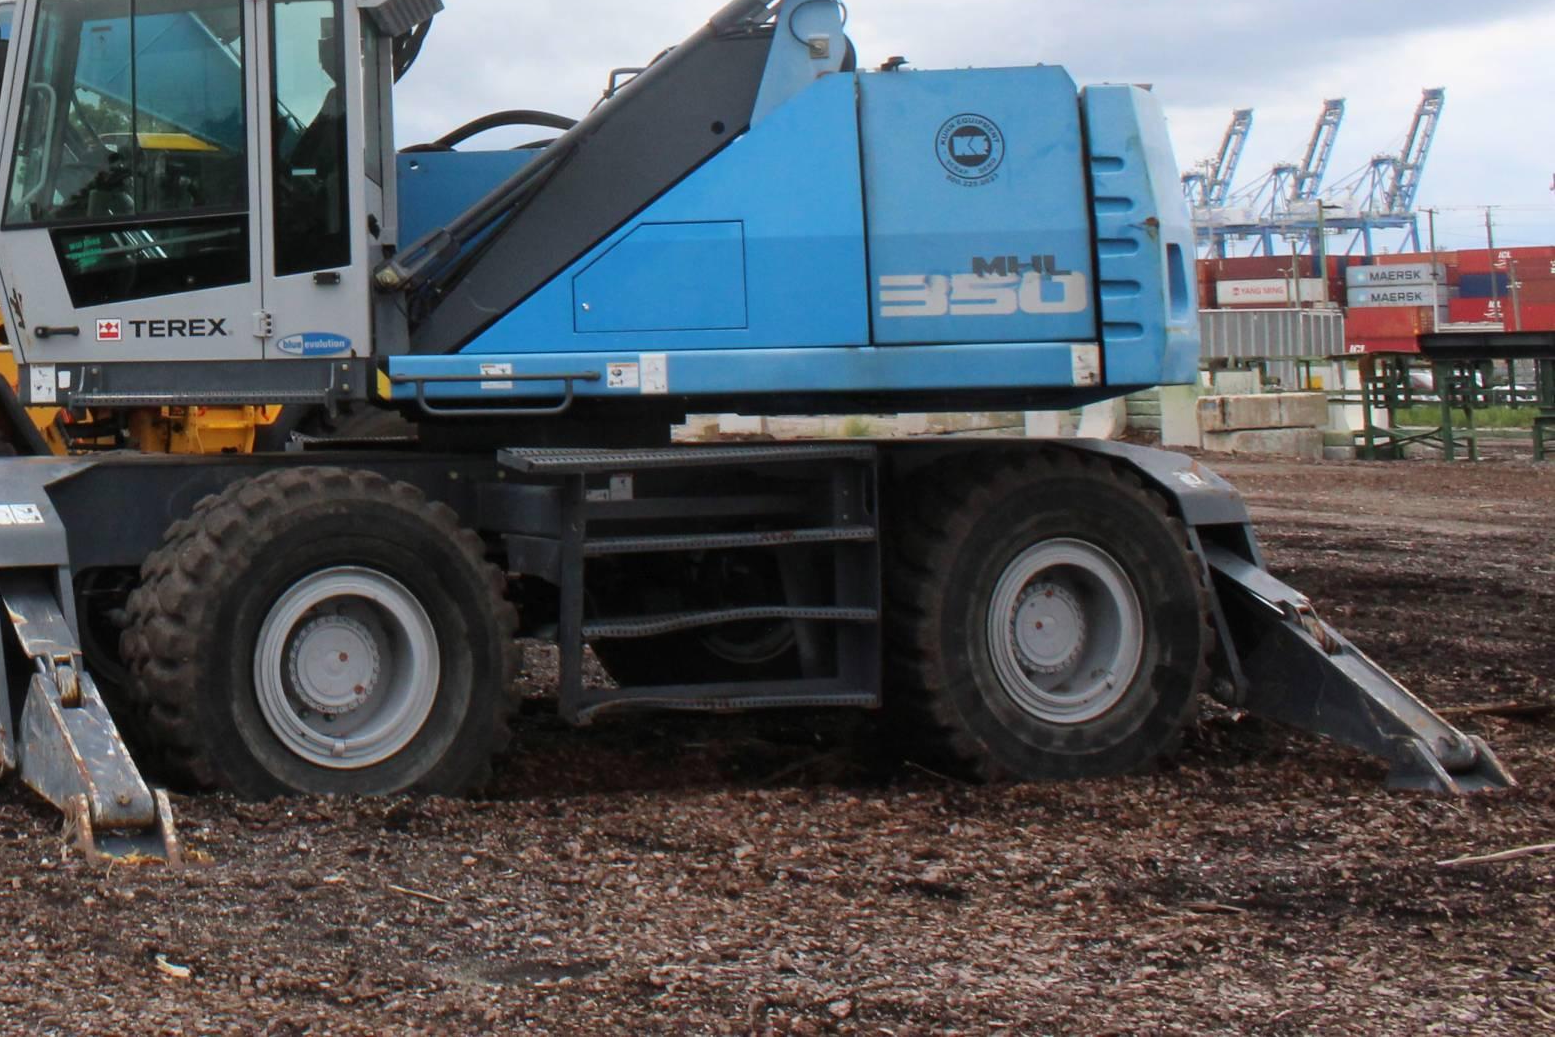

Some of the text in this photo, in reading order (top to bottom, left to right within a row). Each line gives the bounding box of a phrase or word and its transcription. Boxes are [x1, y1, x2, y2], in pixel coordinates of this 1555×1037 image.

[972, 254, 1072, 278] MHL
[1369, 270, 1422, 281] MAERSK
[879, 271, 1088, 317] 350
[1241, 286, 1284, 296] YANG MING
[1370, 291, 1423, 302] MAERSK
[128, 317, 228, 338] TEREX
[283, 338, 345, 349] blue evolution
